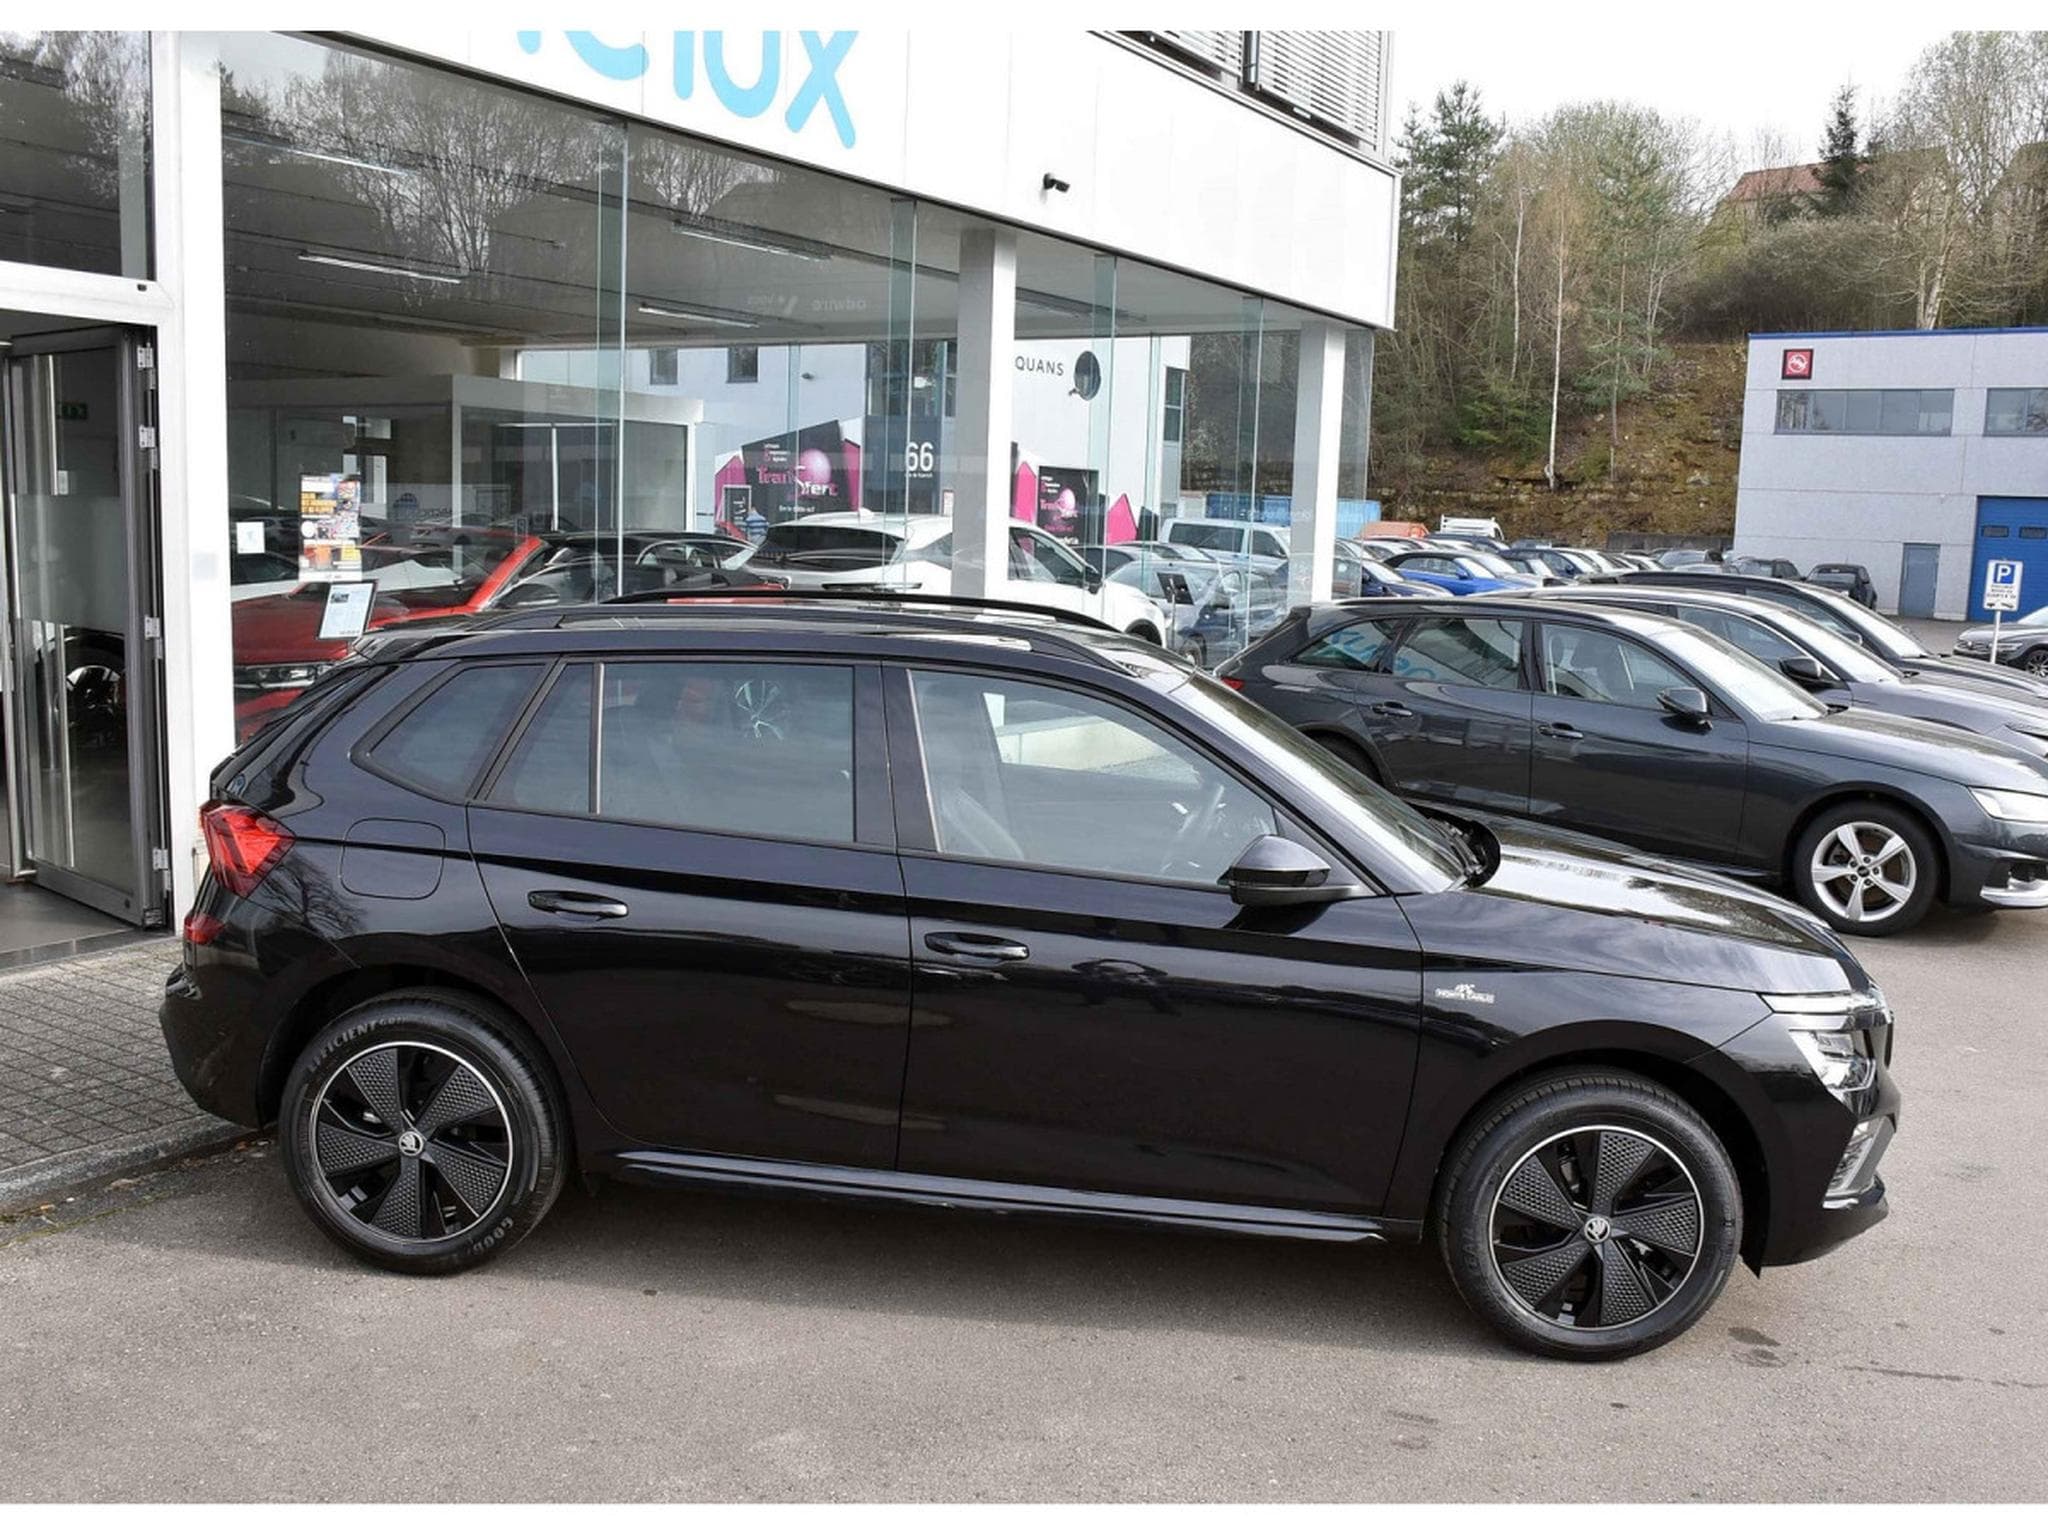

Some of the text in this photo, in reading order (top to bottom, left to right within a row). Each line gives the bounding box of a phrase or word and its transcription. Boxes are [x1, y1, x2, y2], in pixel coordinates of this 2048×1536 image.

[1014, 355, 1065, 377] QUANS
[905, 441, 935, 472] 66
[1996, 564, 2012, 582] P
